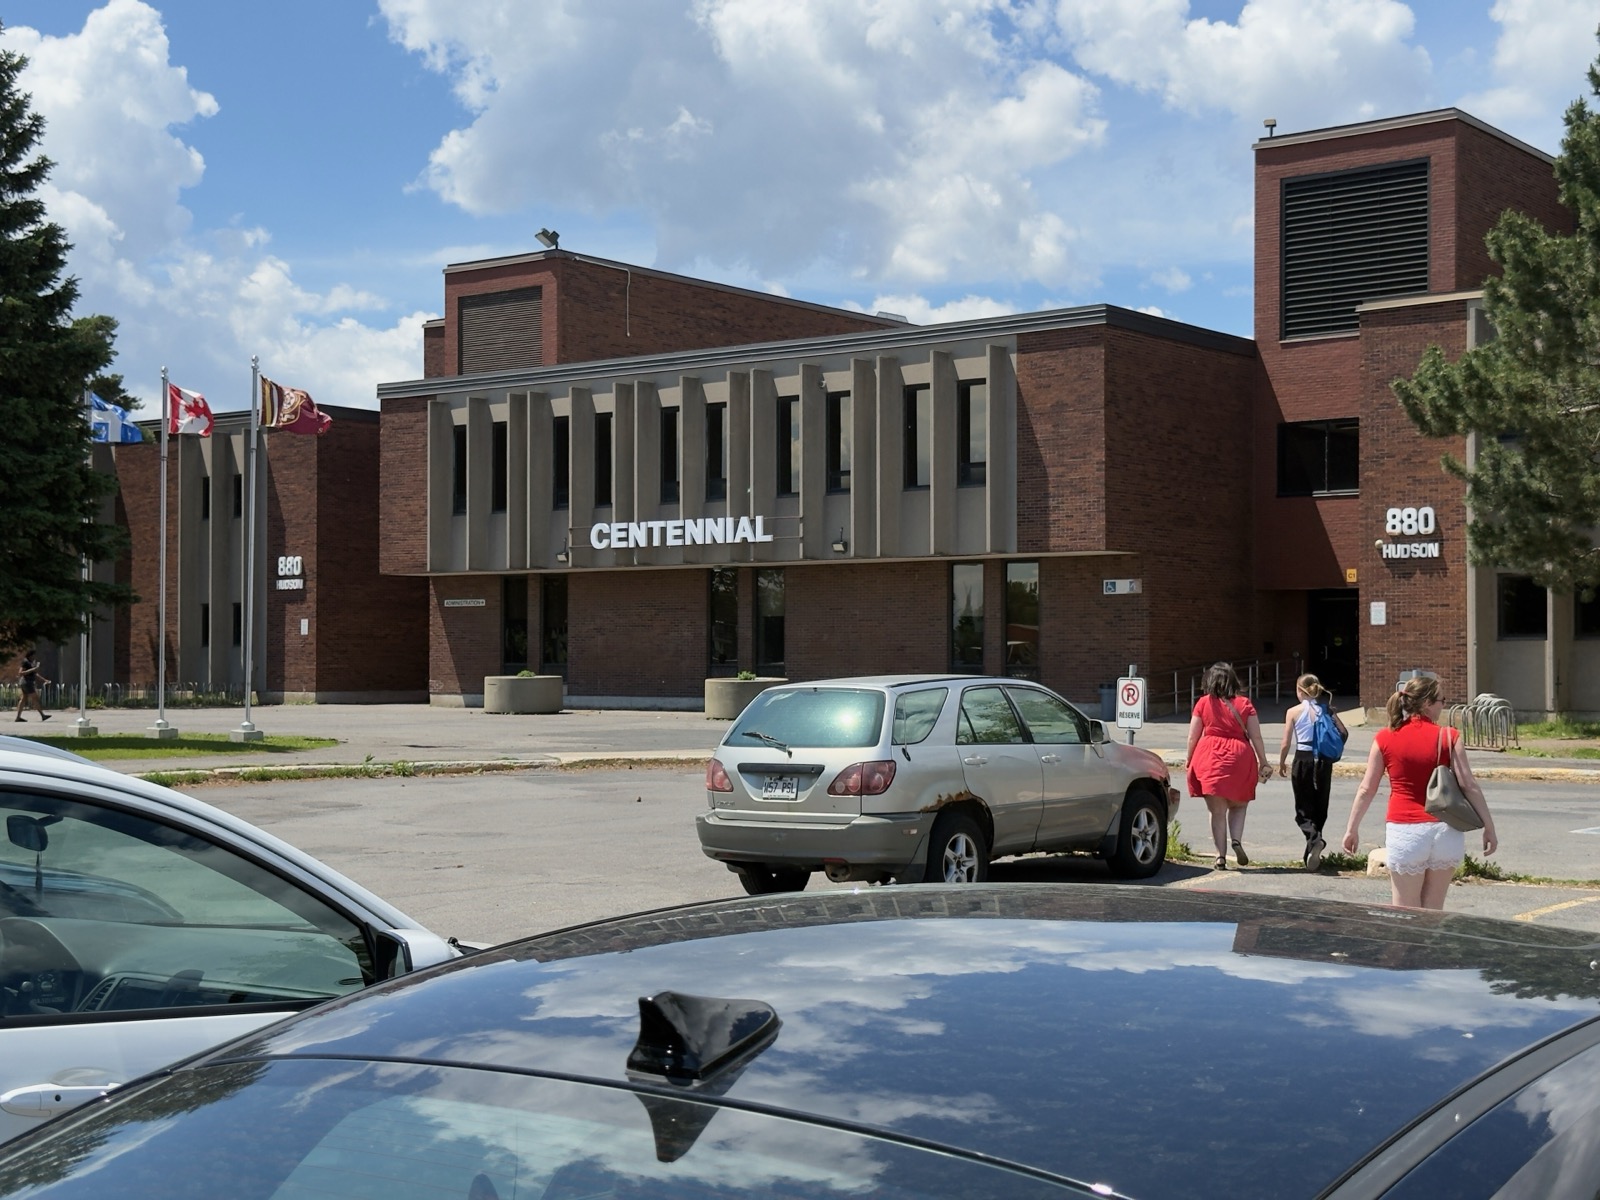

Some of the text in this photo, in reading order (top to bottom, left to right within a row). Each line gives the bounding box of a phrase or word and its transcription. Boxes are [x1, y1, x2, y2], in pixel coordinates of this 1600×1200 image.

[590, 515, 773, 549] CENTENNIAL
[1386, 506, 1435, 535] 880
[1382, 542, 1439, 558] HUDSON
[278, 556, 302, 575] 880
